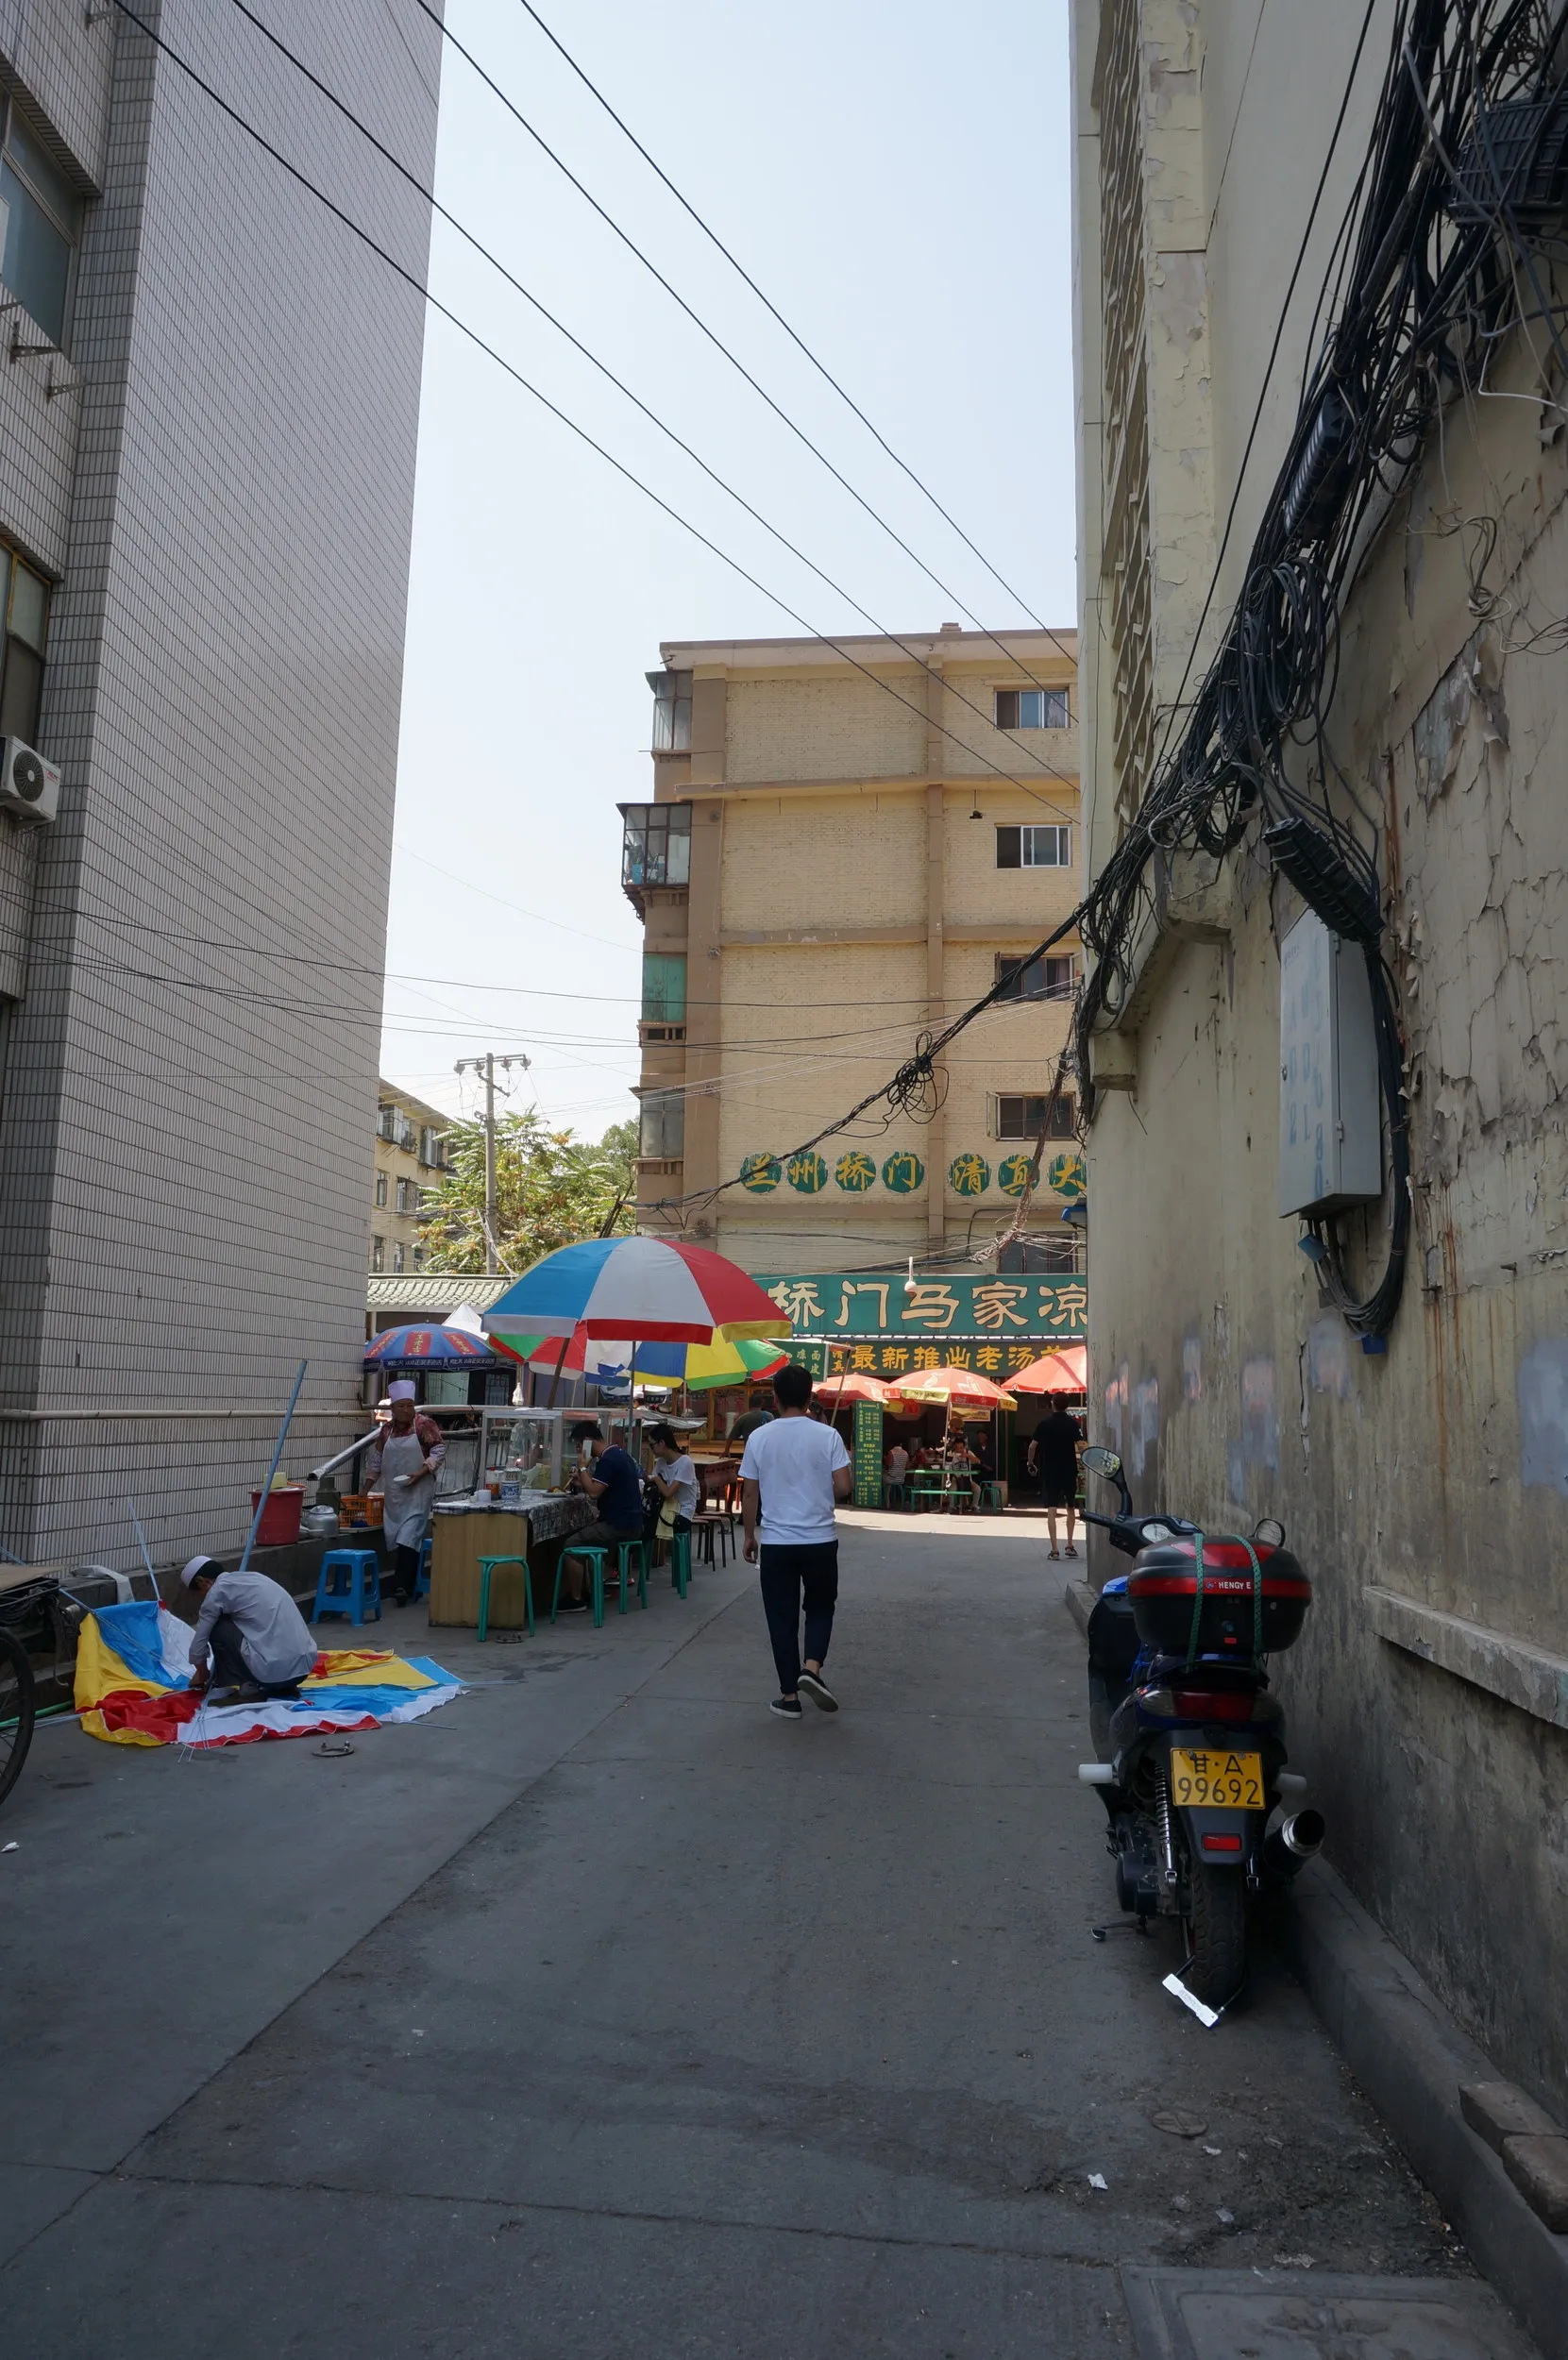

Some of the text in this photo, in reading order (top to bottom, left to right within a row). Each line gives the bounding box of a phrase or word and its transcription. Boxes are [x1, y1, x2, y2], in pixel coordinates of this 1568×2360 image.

[767, 1280, 1087, 1330] 桥门马家凉
[1177, 1777, 1260, 1805] 99692
